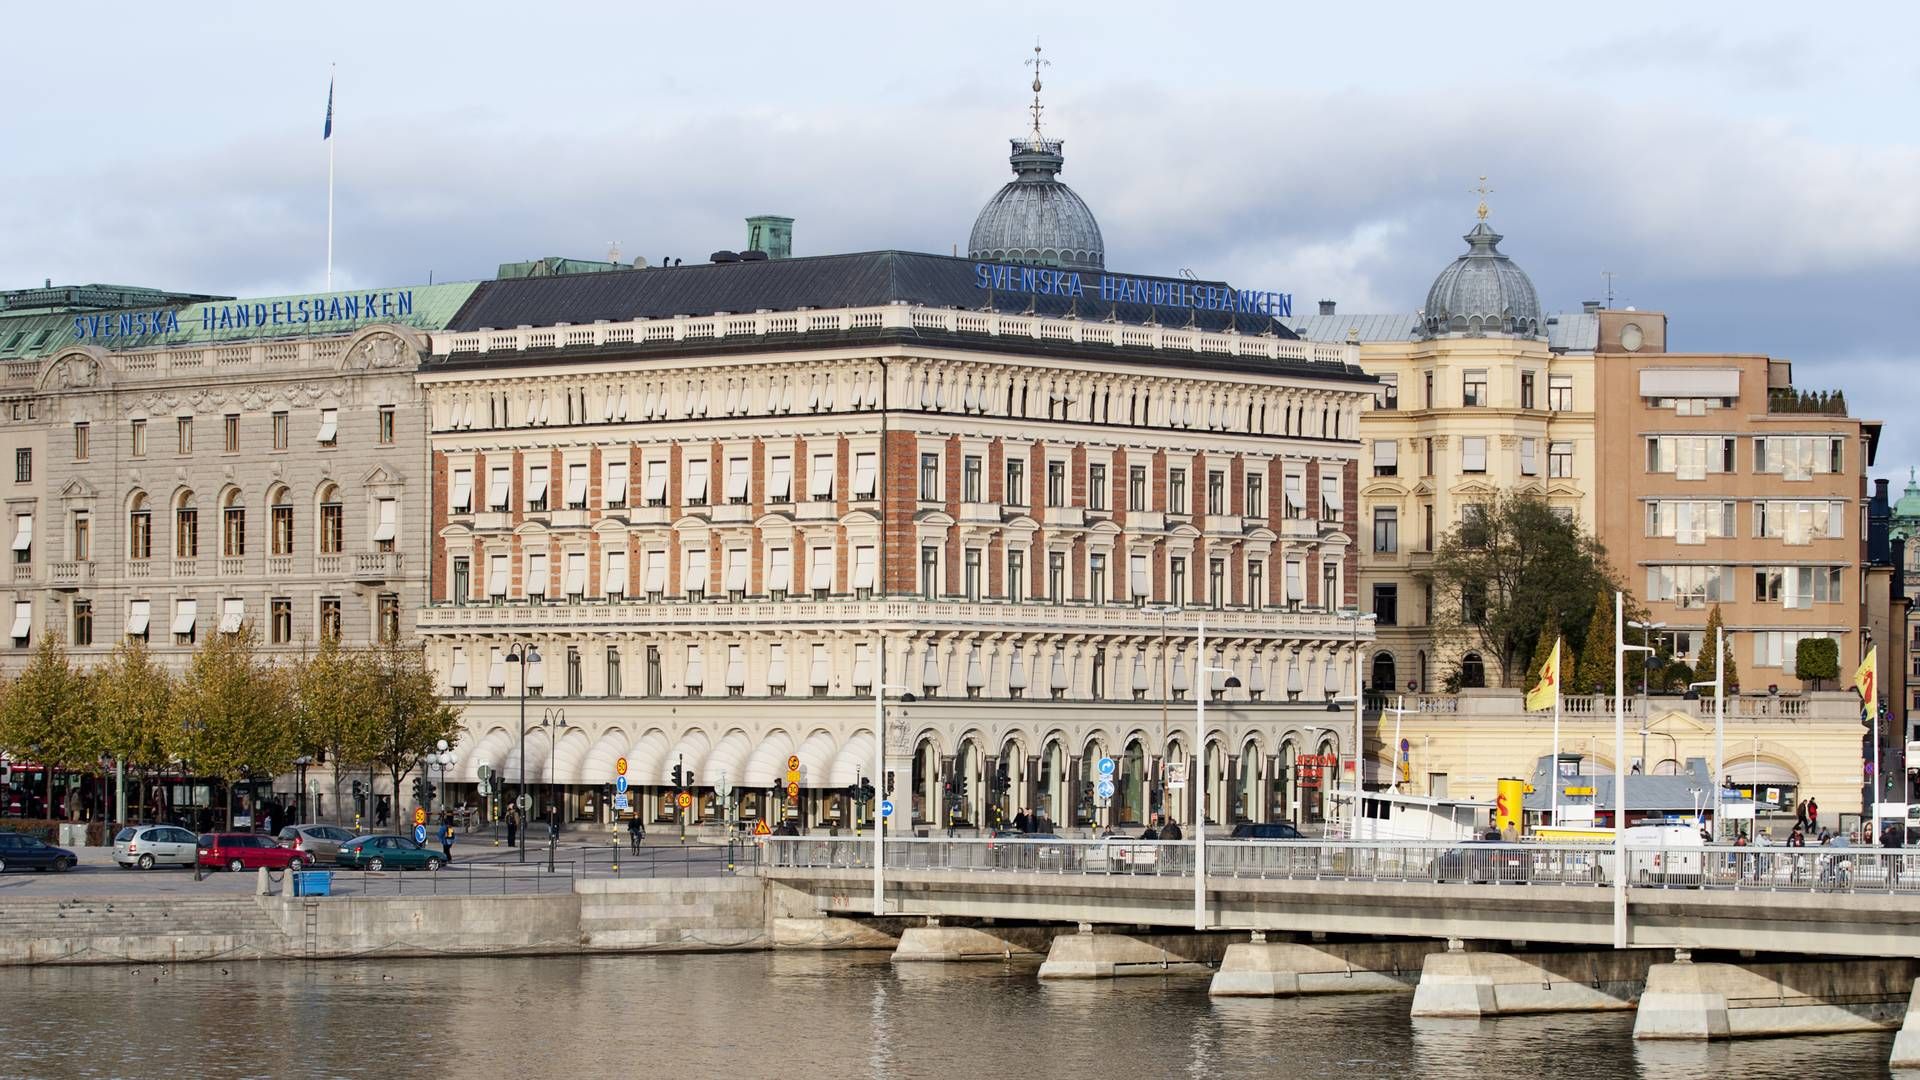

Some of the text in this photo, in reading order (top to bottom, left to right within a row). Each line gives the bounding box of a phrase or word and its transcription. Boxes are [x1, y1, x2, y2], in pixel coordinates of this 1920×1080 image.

[73, 291, 413, 339] SVENSKA HANDELSBANKEN
[975, 263, 1292, 318] SVENSKA HANDELSBANKEN
